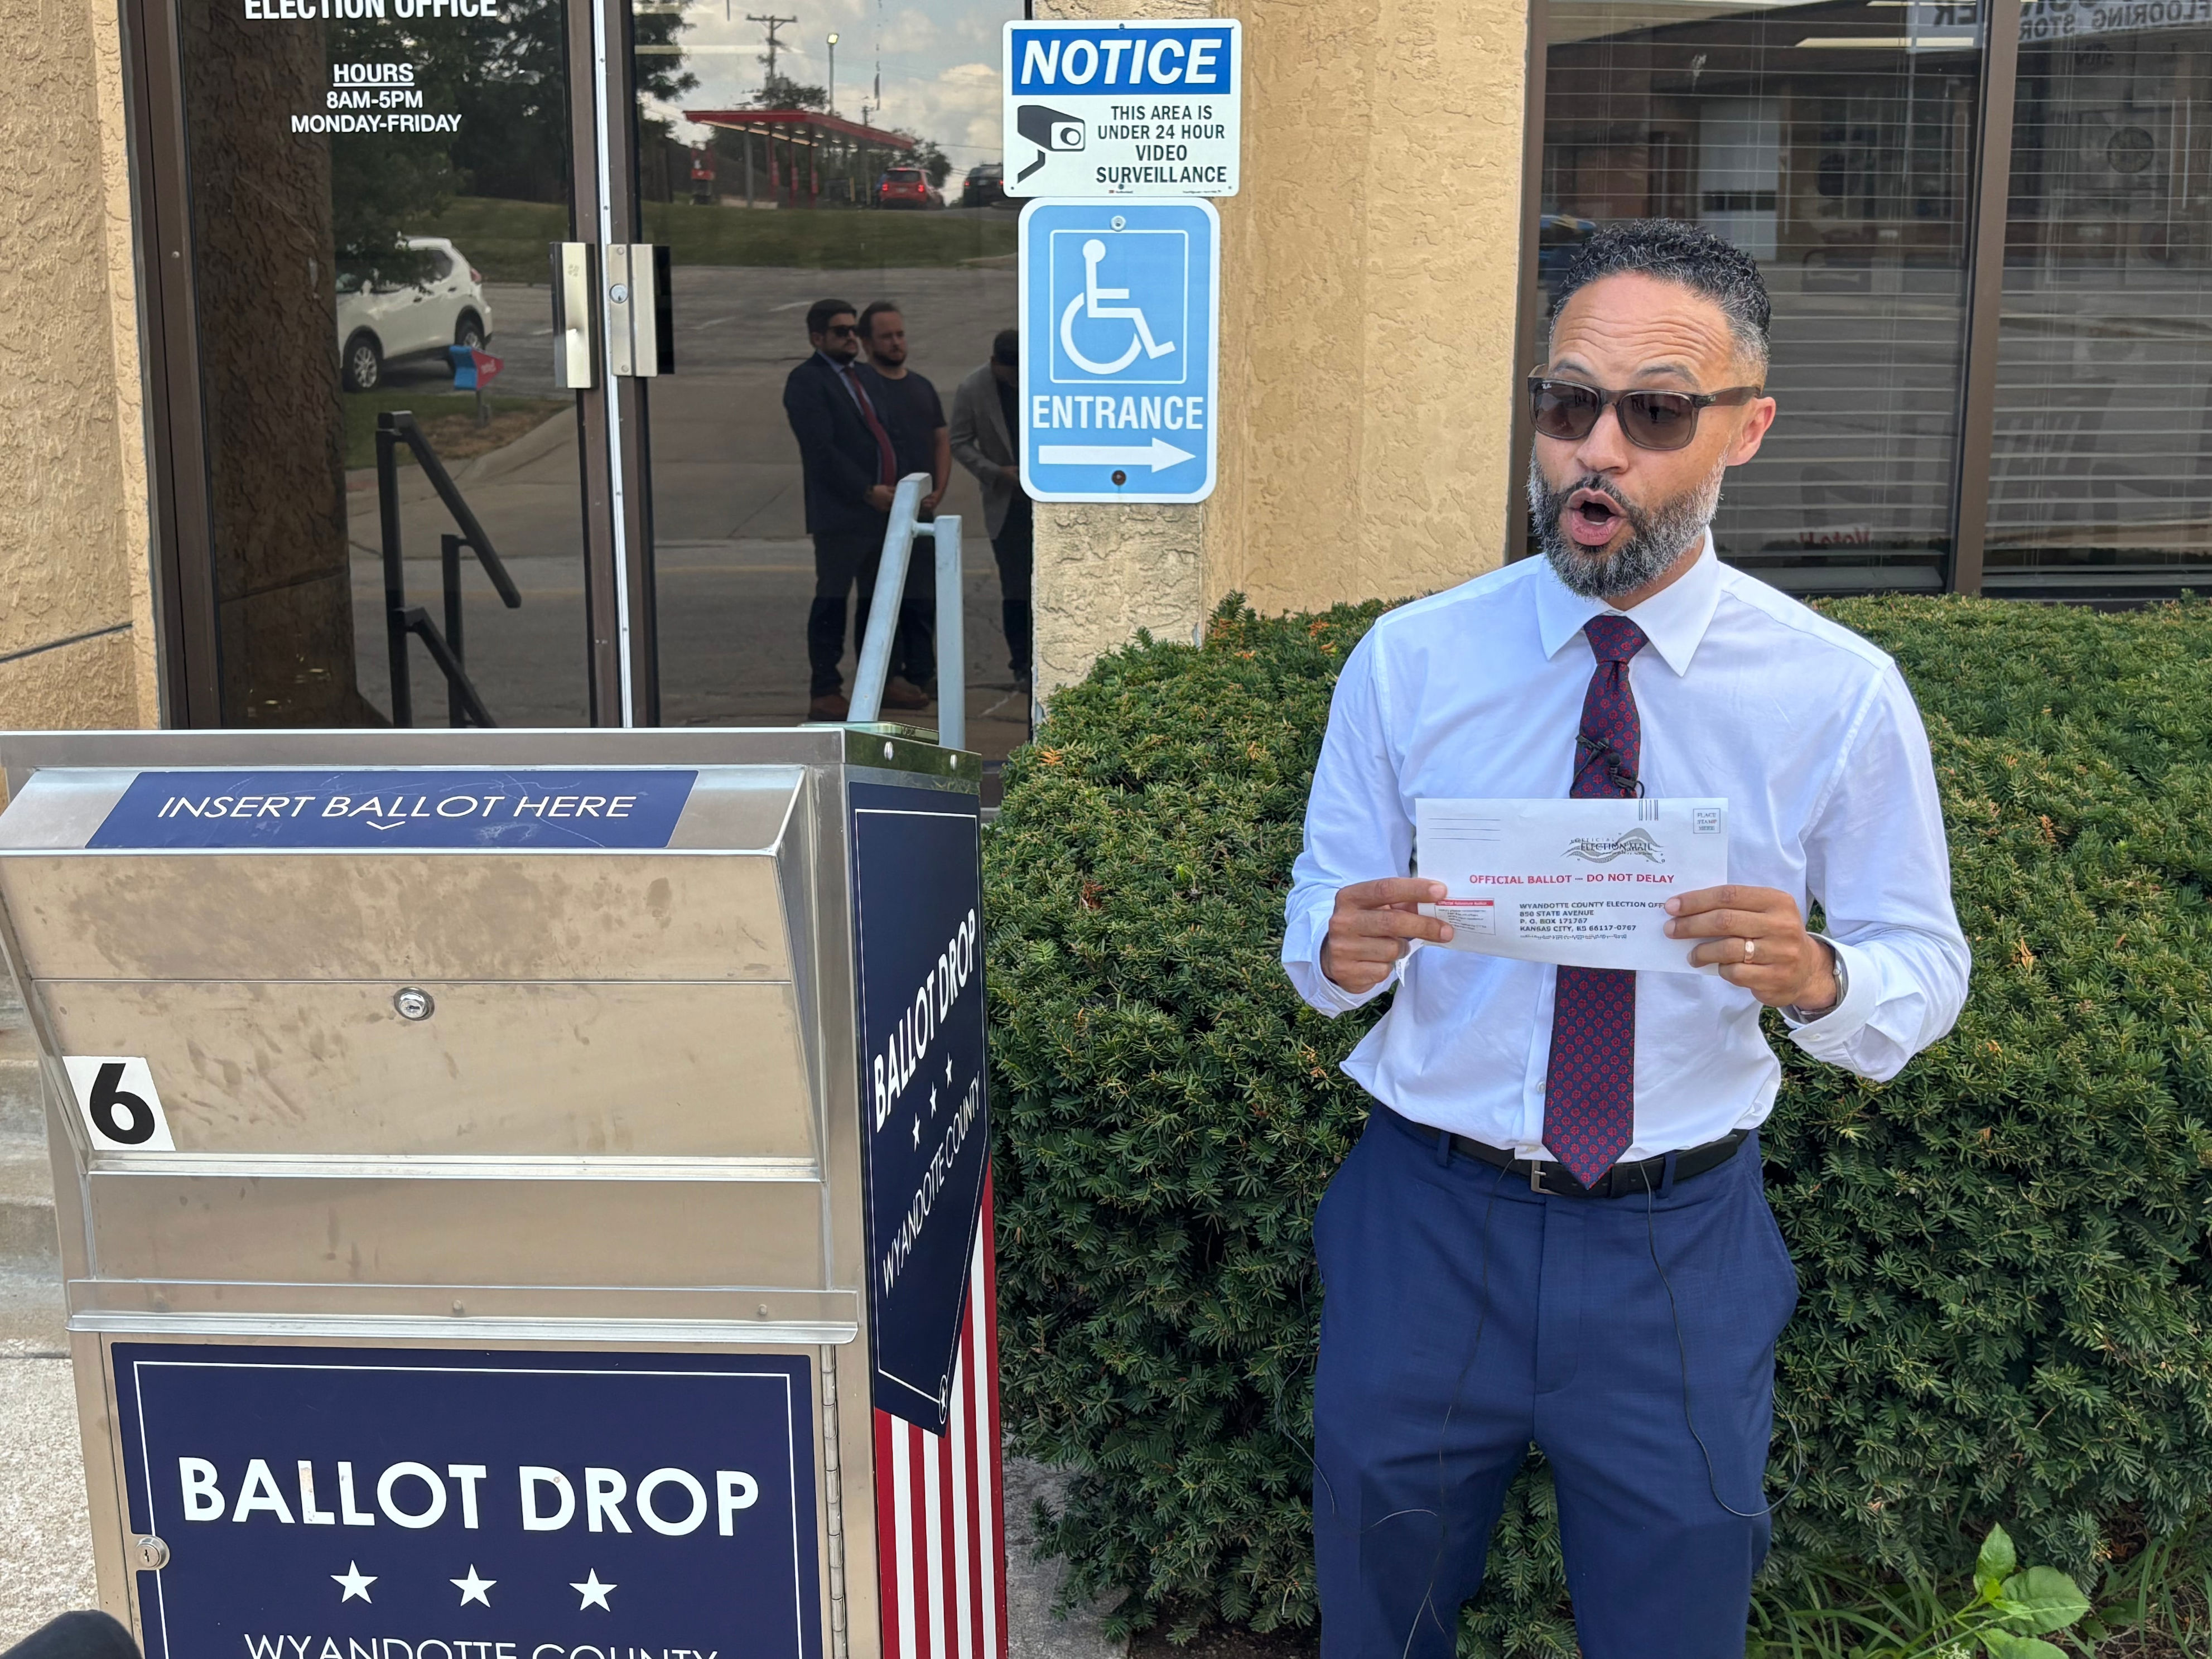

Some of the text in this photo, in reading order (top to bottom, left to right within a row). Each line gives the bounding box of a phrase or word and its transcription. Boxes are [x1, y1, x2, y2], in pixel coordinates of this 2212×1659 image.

[245, 0, 498, 19] ELECTION OFFICE
[1021, 38, 1222, 85] NOTICE
[334, 63, 414, 83] HOURS
[326, 90, 423, 109] 8AM-5PM
[1111, 105, 1212, 120] THIS AREA IS
[291, 114, 462, 133] MONDAY-FRIDAY
[1098, 124, 1225, 139] UNDER 24 HOUR
[1135, 144, 1187, 161] VIDEO
[1096, 166, 1227, 183] SURVEILLANCE
[1032, 396, 1203, 430] ENTRANCE
[157, 795, 637, 818] INSERT BALLOT HERE
[1469, 875, 1524, 884] OFFICIAL
[1527, 875, 1572, 884] BALLOT
[1587, 874, 1604, 882] DO
[1608, 873, 1632, 882] NOT
[1636, 874, 1674, 883] DELAY
[874, 908, 975, 1133] BALLOT DROP
[89, 1063, 155, 1145] 6
[883, 1070, 980, 1299] WYANDOTTE COUNTY
[179, 1457, 759, 1536] BALLOT DROP
